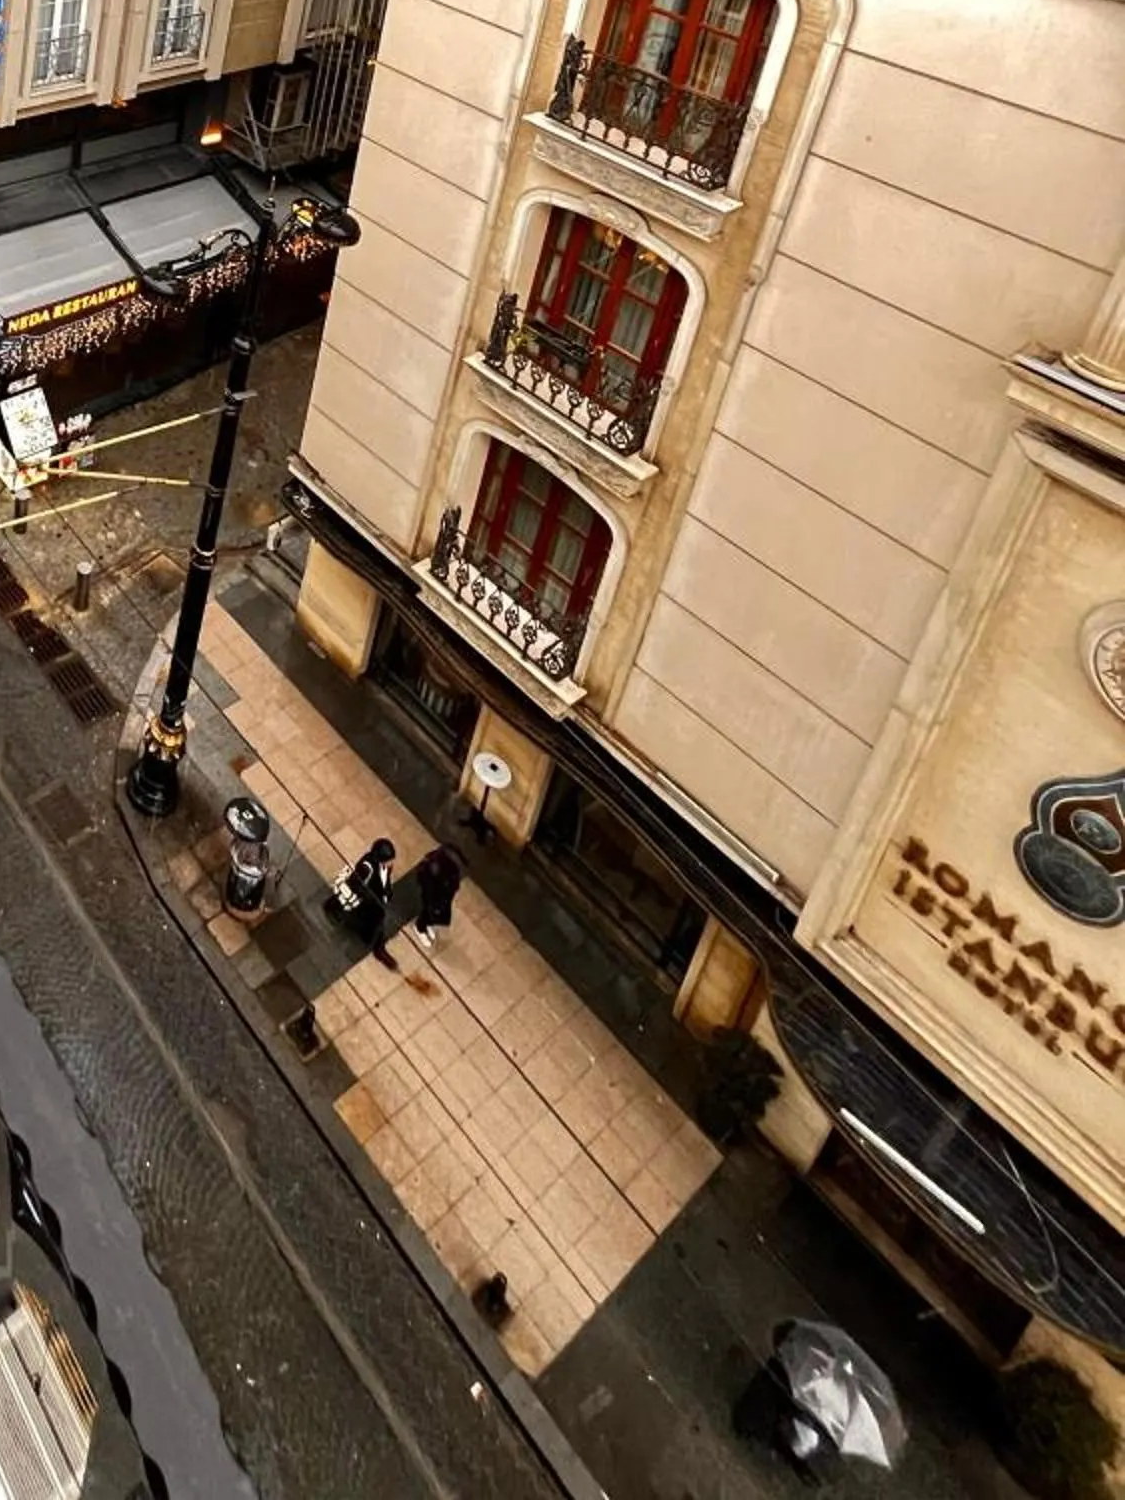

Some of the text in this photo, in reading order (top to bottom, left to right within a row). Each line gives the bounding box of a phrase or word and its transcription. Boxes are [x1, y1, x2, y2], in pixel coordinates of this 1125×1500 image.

[8, 280, 138, 333] NEDA RESTAURAN
[893, 869, 1125, 1085] ISTANBU
